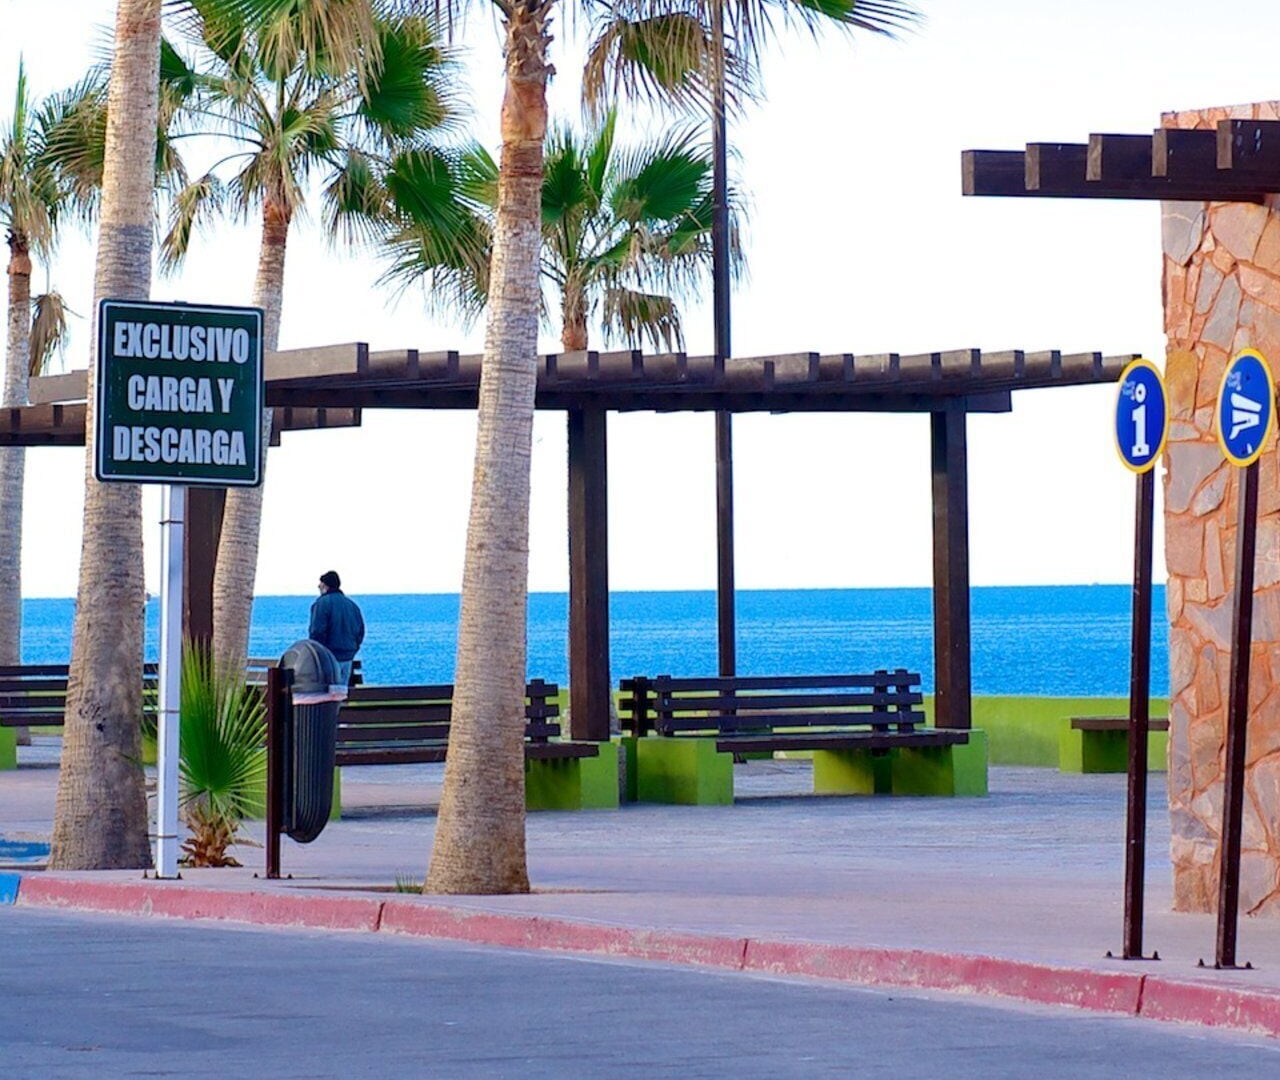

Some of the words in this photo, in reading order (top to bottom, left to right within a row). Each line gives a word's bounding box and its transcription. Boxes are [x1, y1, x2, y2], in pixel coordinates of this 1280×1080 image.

[113, 321, 250, 365] EXCLUSIVO
[127, 374, 214, 414] CARGA
[217, 378, 235, 414] Y
[113, 425, 247, 466] DESCARGA
